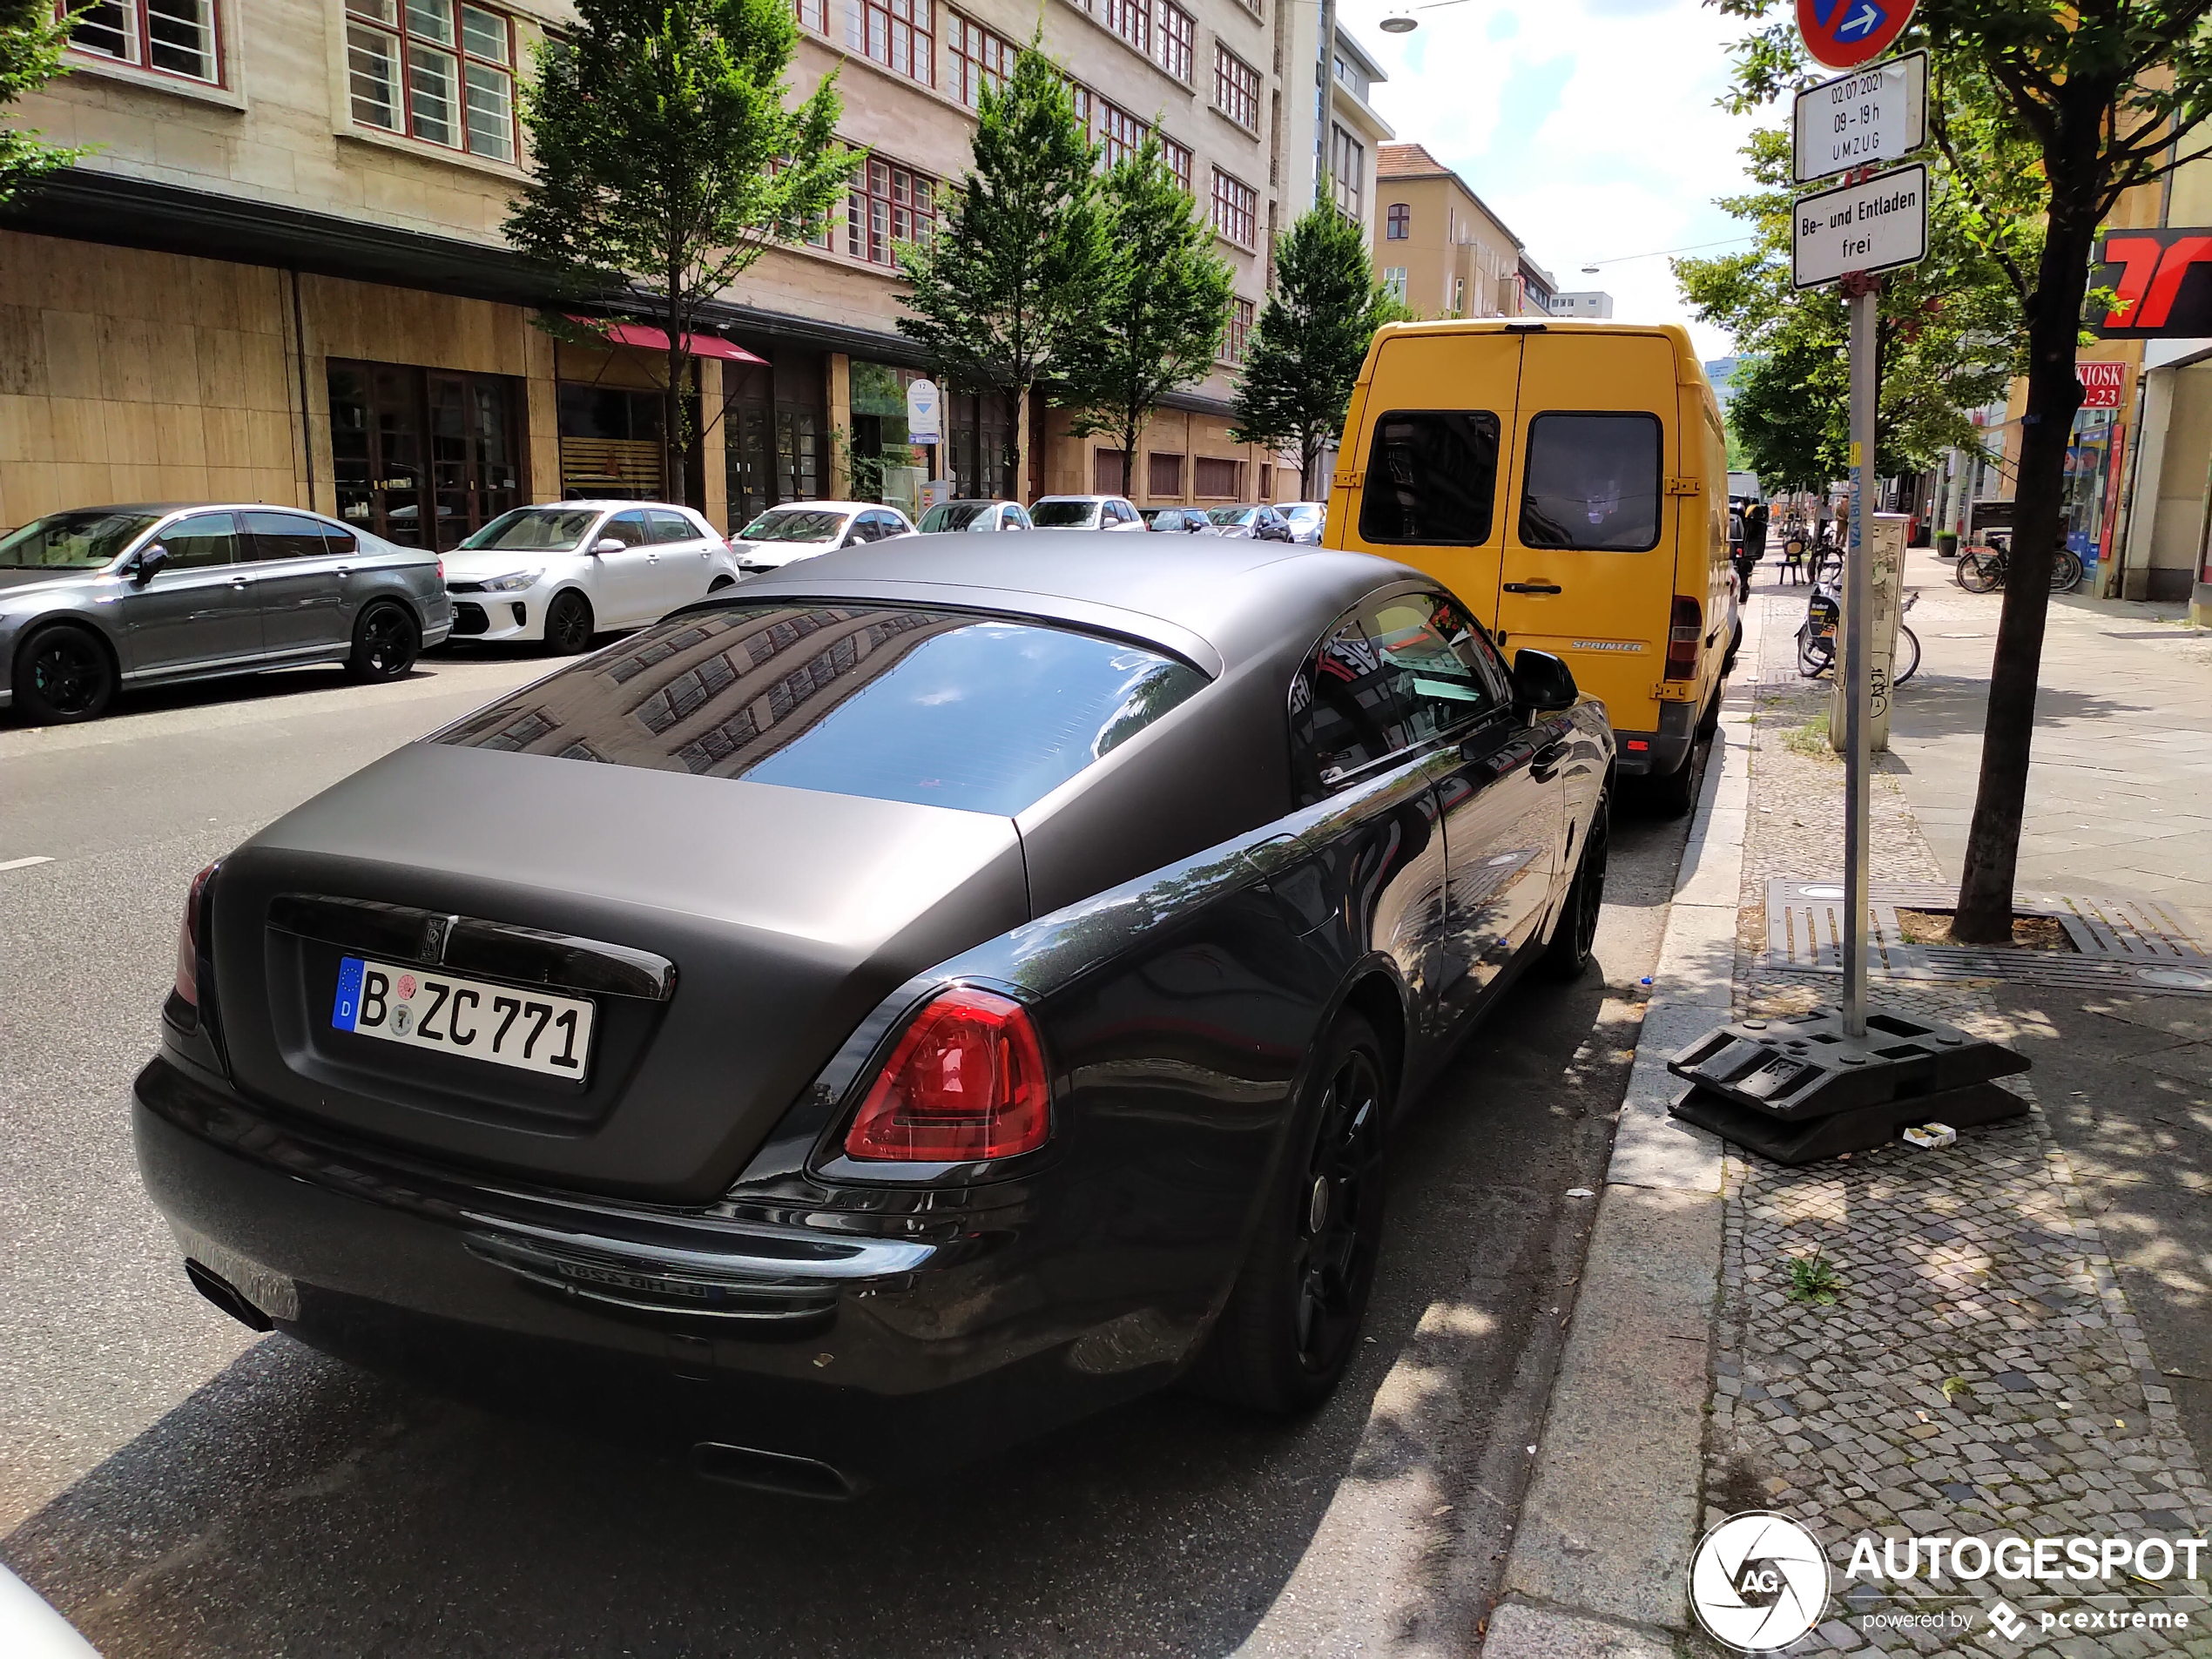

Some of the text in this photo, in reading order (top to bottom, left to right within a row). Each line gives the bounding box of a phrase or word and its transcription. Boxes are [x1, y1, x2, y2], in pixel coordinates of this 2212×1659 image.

[1831, 71, 1883, 105] 02.07.2021
[1832, 132, 1879, 160] UMZUG
[1802, 191, 1916, 237] Be- und Entladen
[1842, 233, 1871, 258] frei
[2075, 365, 2122, 387] KIOSK
[1572, 640, 1643, 651] SPRINTER
[341, 1000, 351, 1018] D
[359, 970, 390, 1028] B
[416, 981, 481, 1046] ZC
[492, 995, 579, 1069] 771
